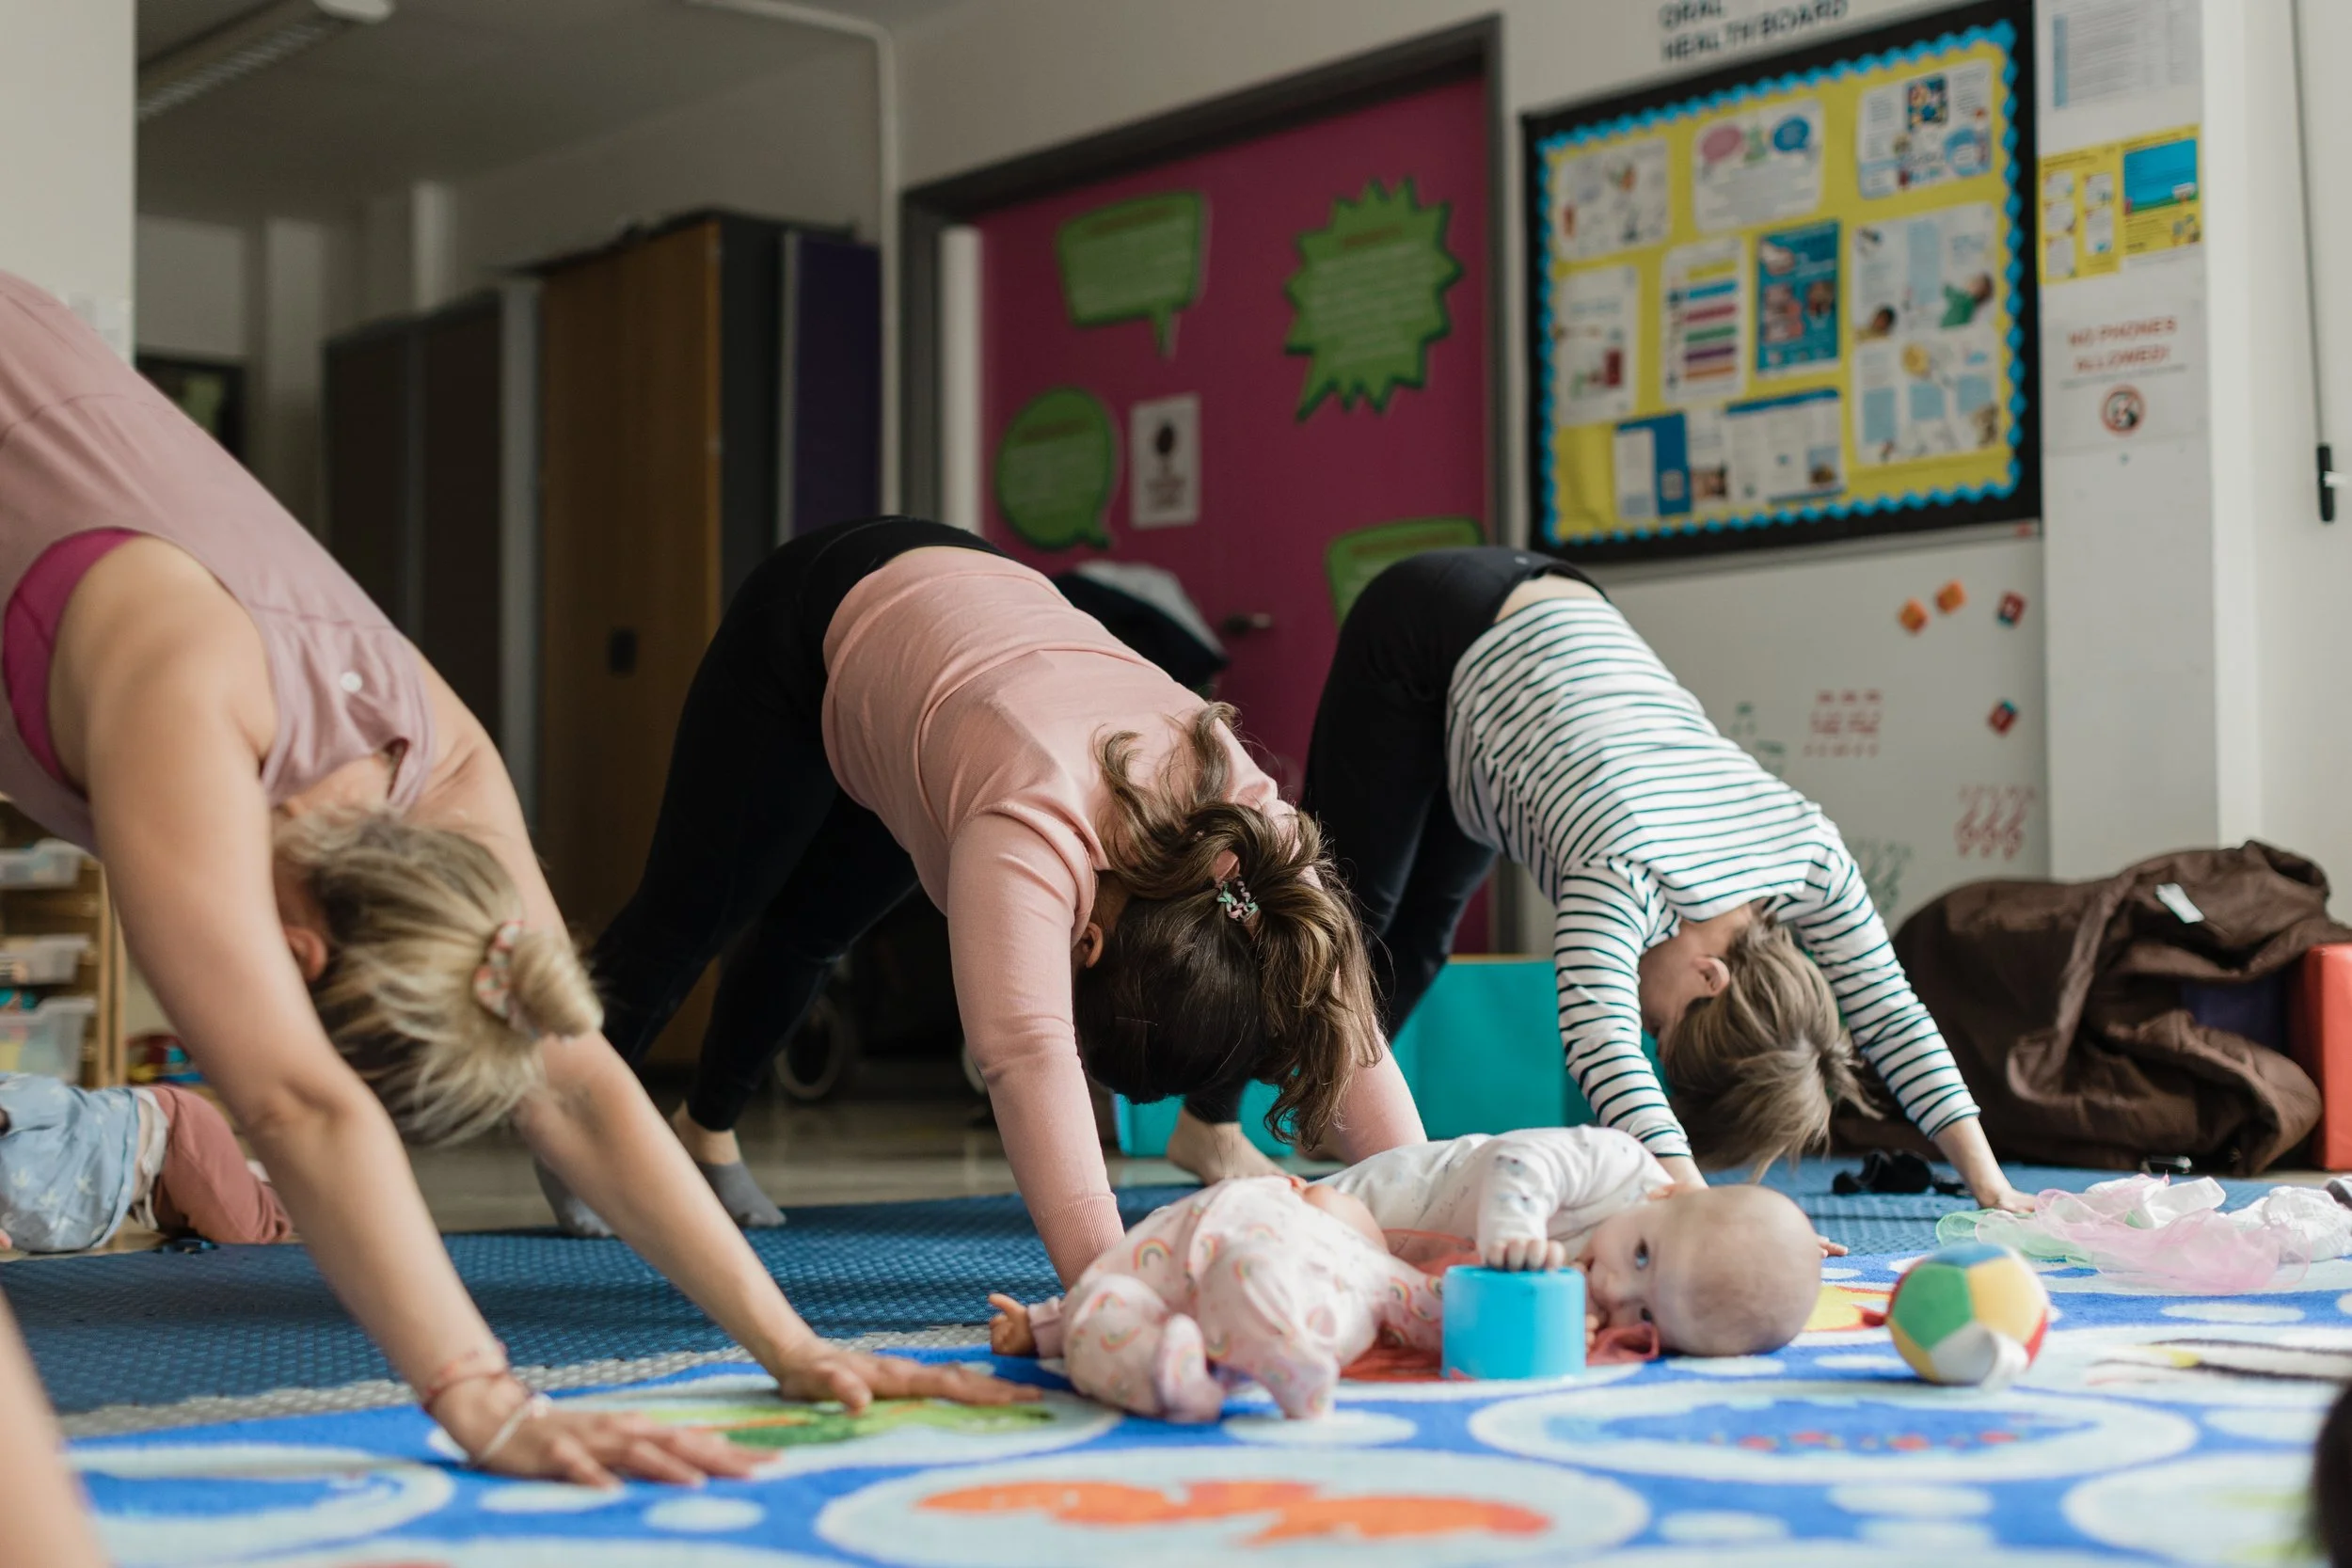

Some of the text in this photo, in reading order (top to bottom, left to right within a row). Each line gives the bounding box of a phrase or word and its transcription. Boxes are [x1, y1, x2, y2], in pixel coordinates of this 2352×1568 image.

[1660, 0, 1849, 63] HEALTH BOARD
[2067, 315, 2178, 347] NO PHONES
